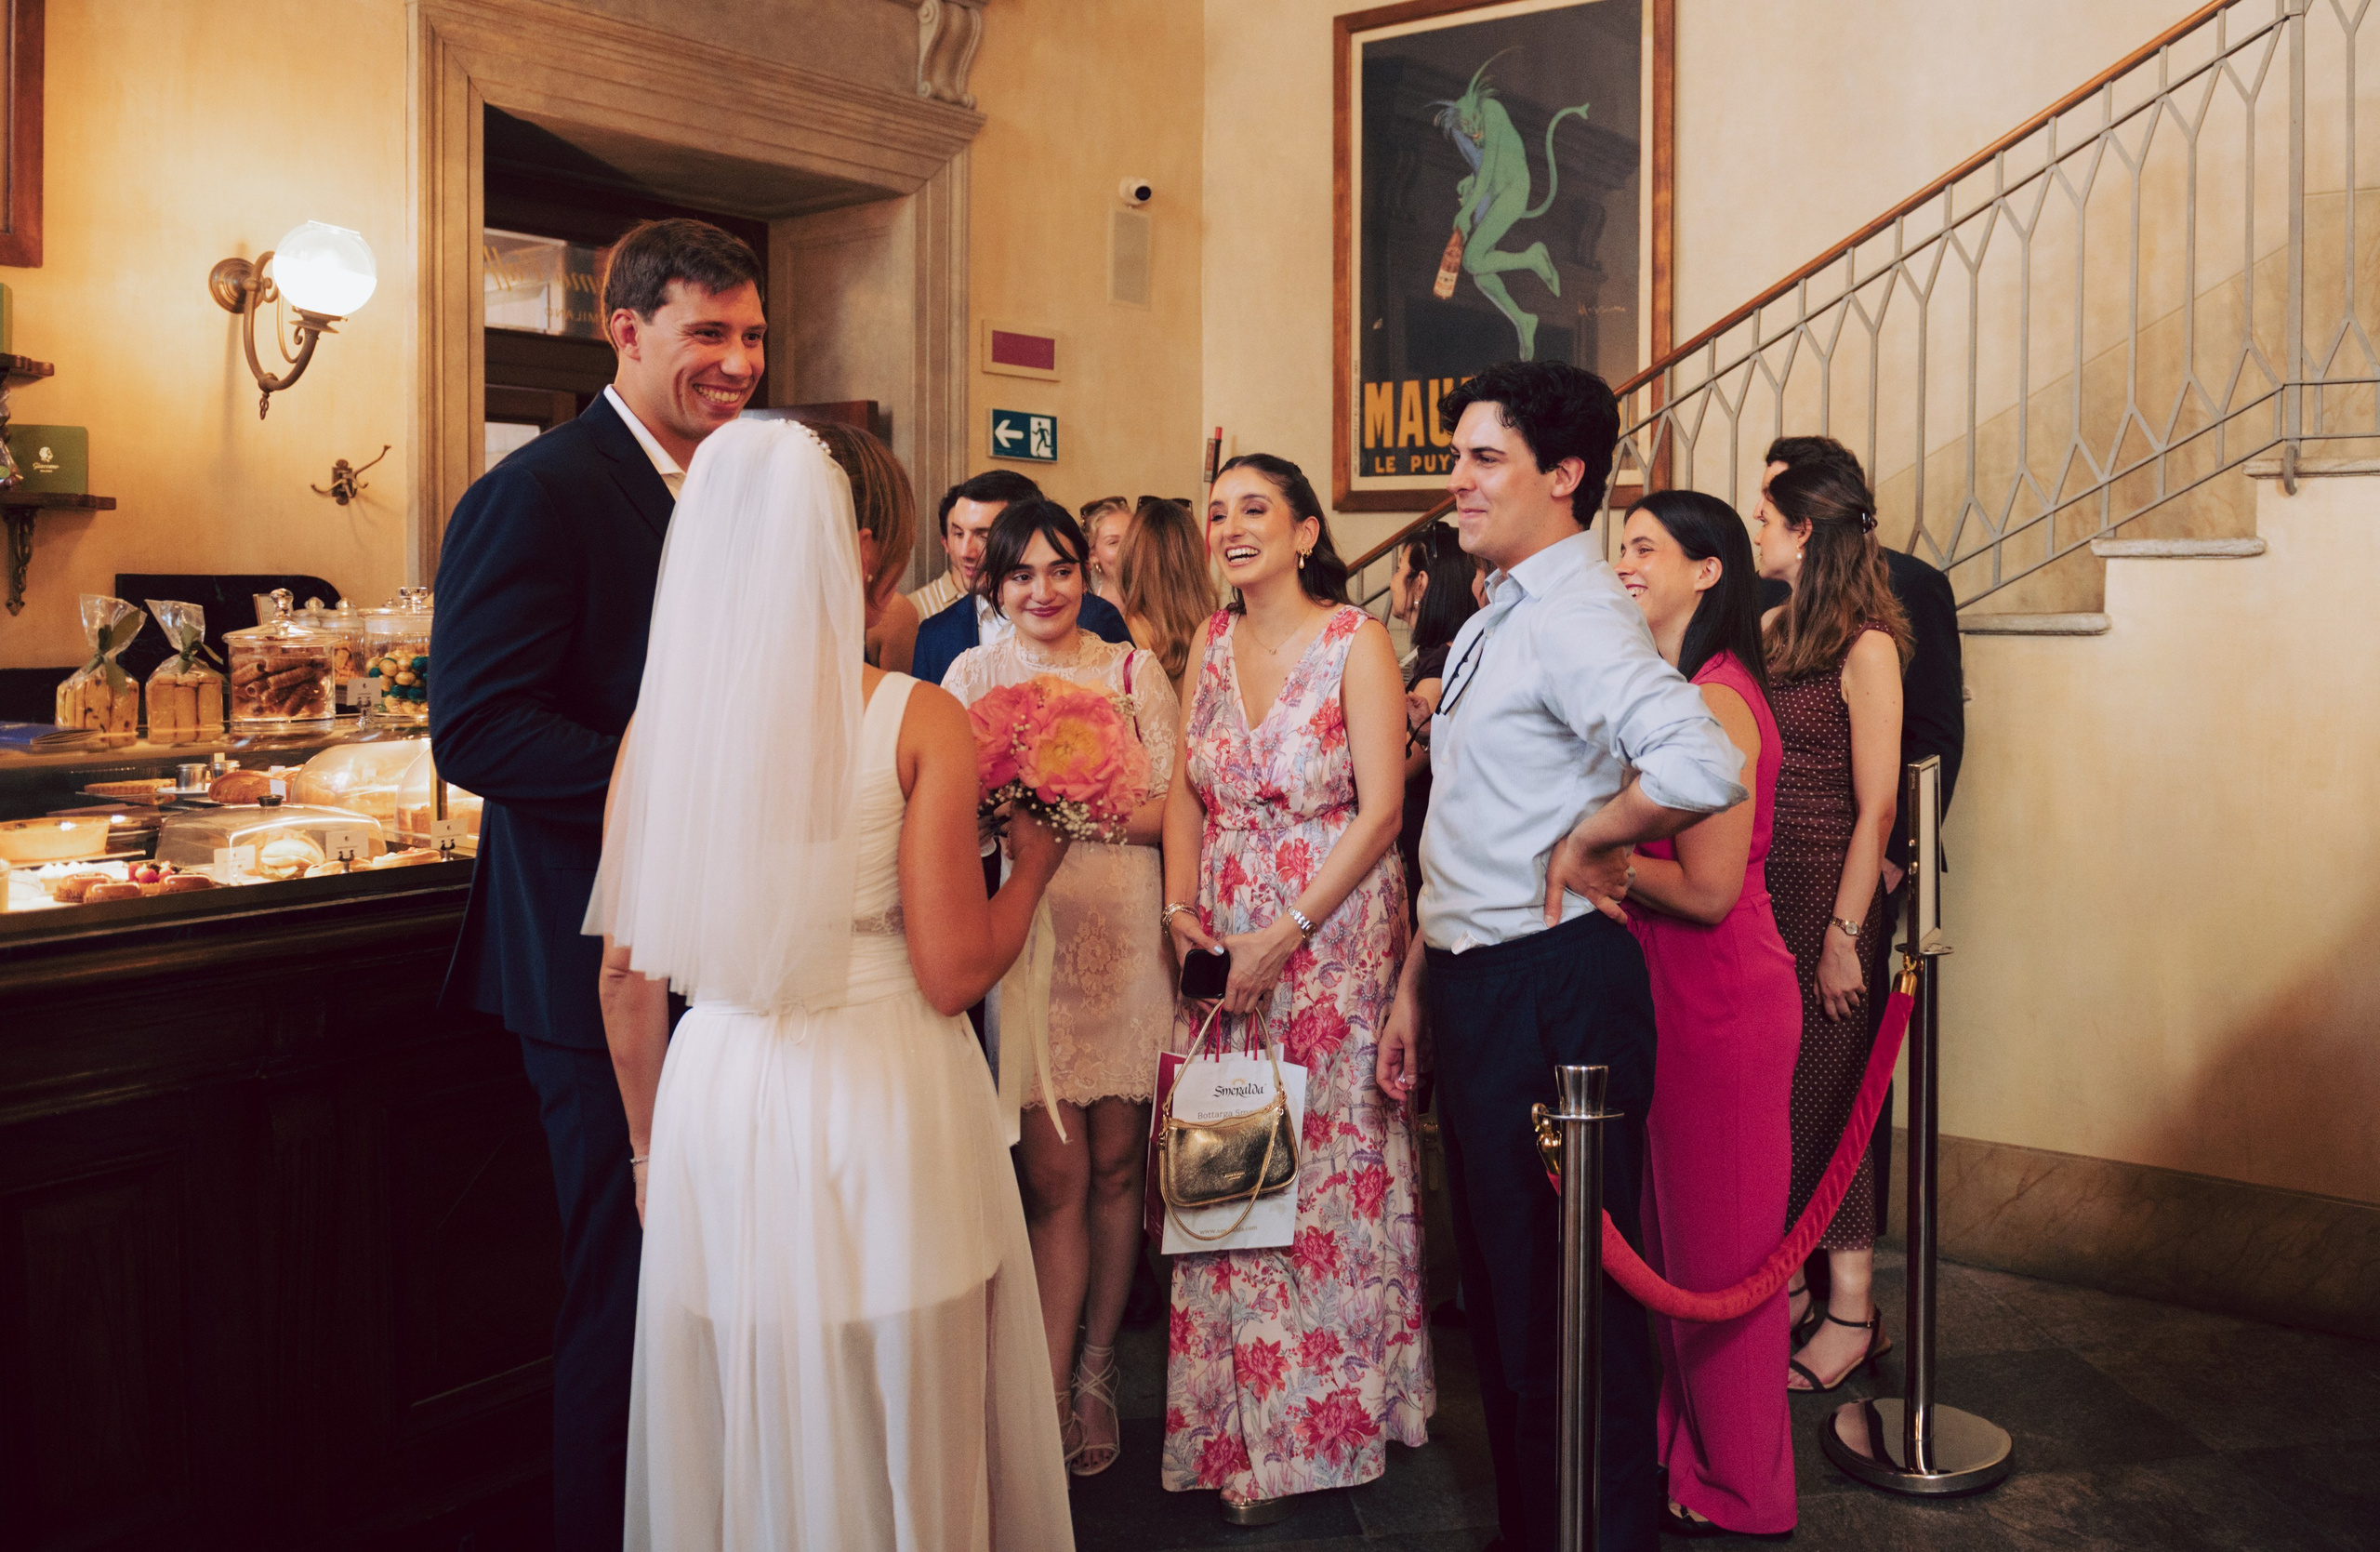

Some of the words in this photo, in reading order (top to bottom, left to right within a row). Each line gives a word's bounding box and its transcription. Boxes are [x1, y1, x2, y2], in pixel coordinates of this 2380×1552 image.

[1364, 377, 1474, 448] MAU
[1375, 456, 1396, 473] LE
[1410, 454, 1450, 472] PUY
[1212, 1083, 1264, 1098] Smeralda
[1197, 1110, 1233, 1120] Bottarga
